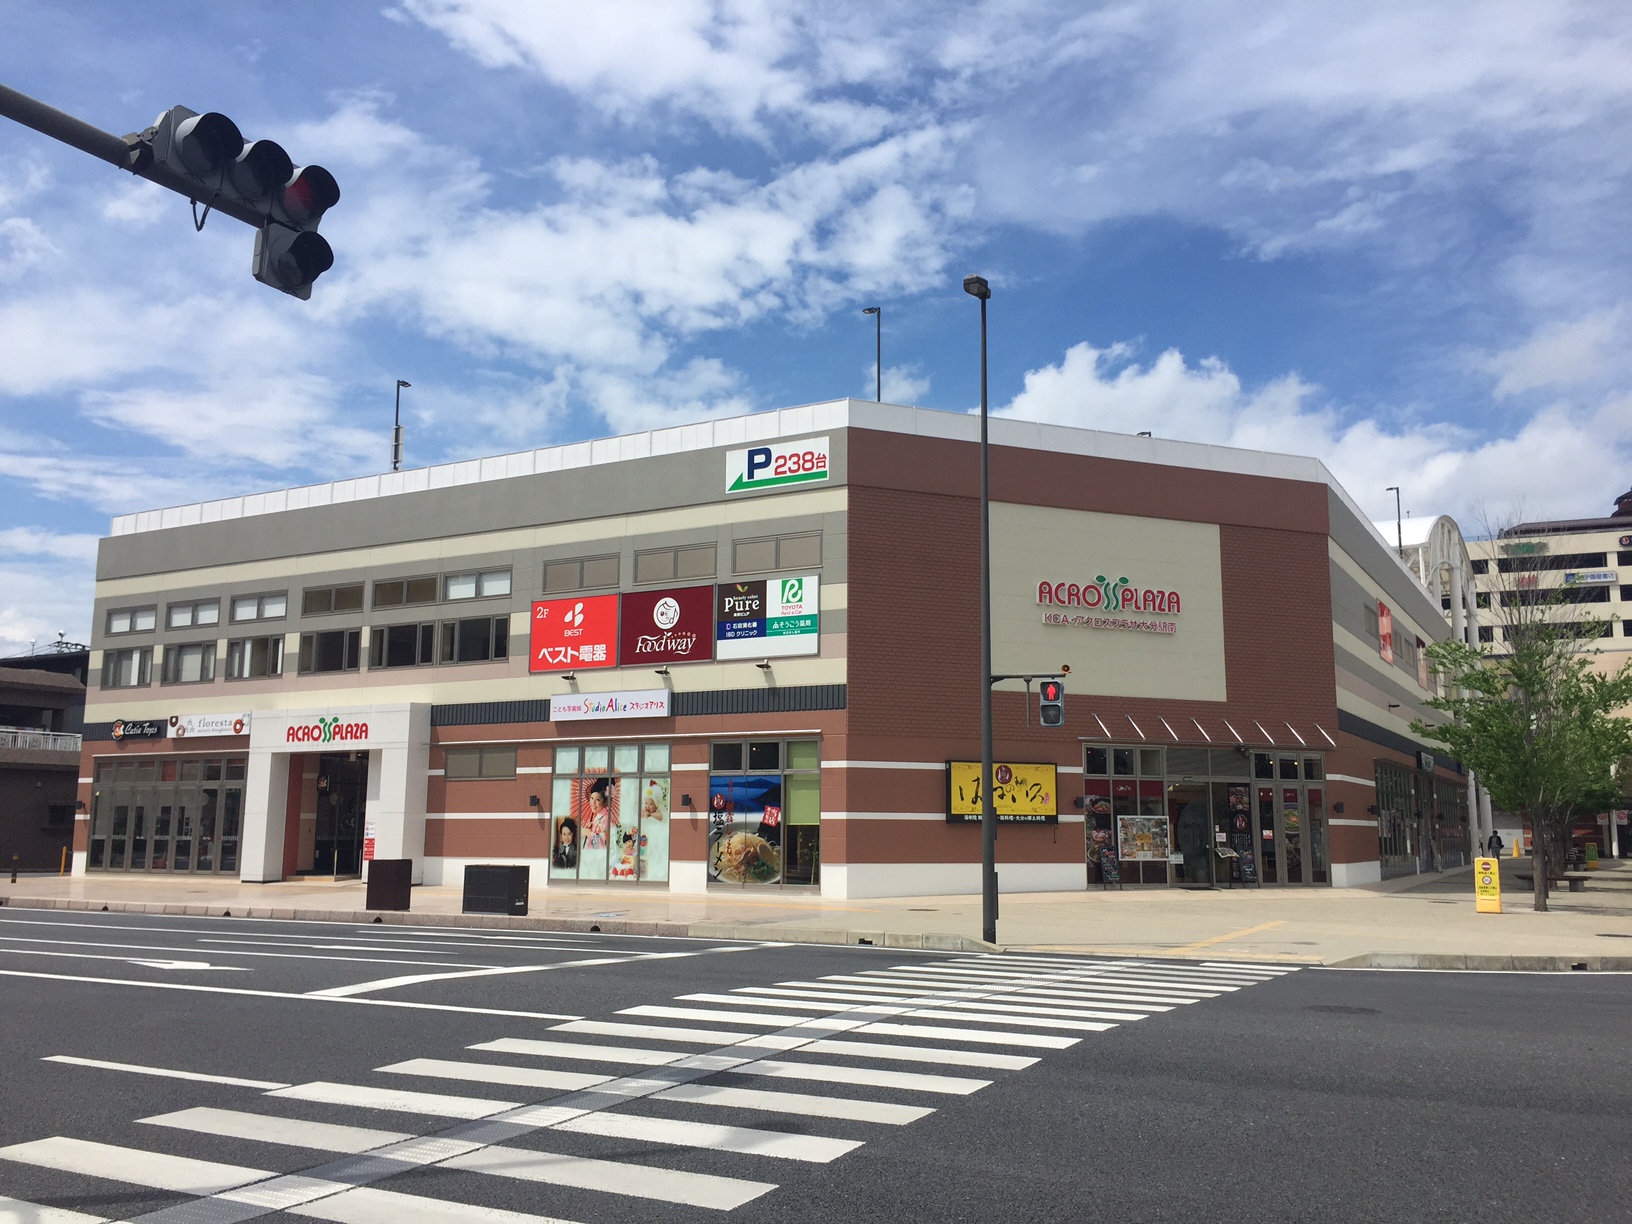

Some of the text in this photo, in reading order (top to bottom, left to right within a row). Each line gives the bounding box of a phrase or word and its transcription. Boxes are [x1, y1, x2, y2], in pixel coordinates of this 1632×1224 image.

[747, 447, 827, 480] P 238台
[724, 597, 760, 612] Pure
[536, 606, 549, 619] 2F
[564, 628, 583, 637] BEST
[736, 629, 758, 637] クリニック
[635, 635, 697, 655] Foodway
[538, 644, 607, 664] ベスト電器
[629, 701, 665, 711] スタジオアリス
[142, 721, 158, 736] Tops
[198, 717, 233, 728] floresta
[712, 811, 725, 880] 塩ラーメン
